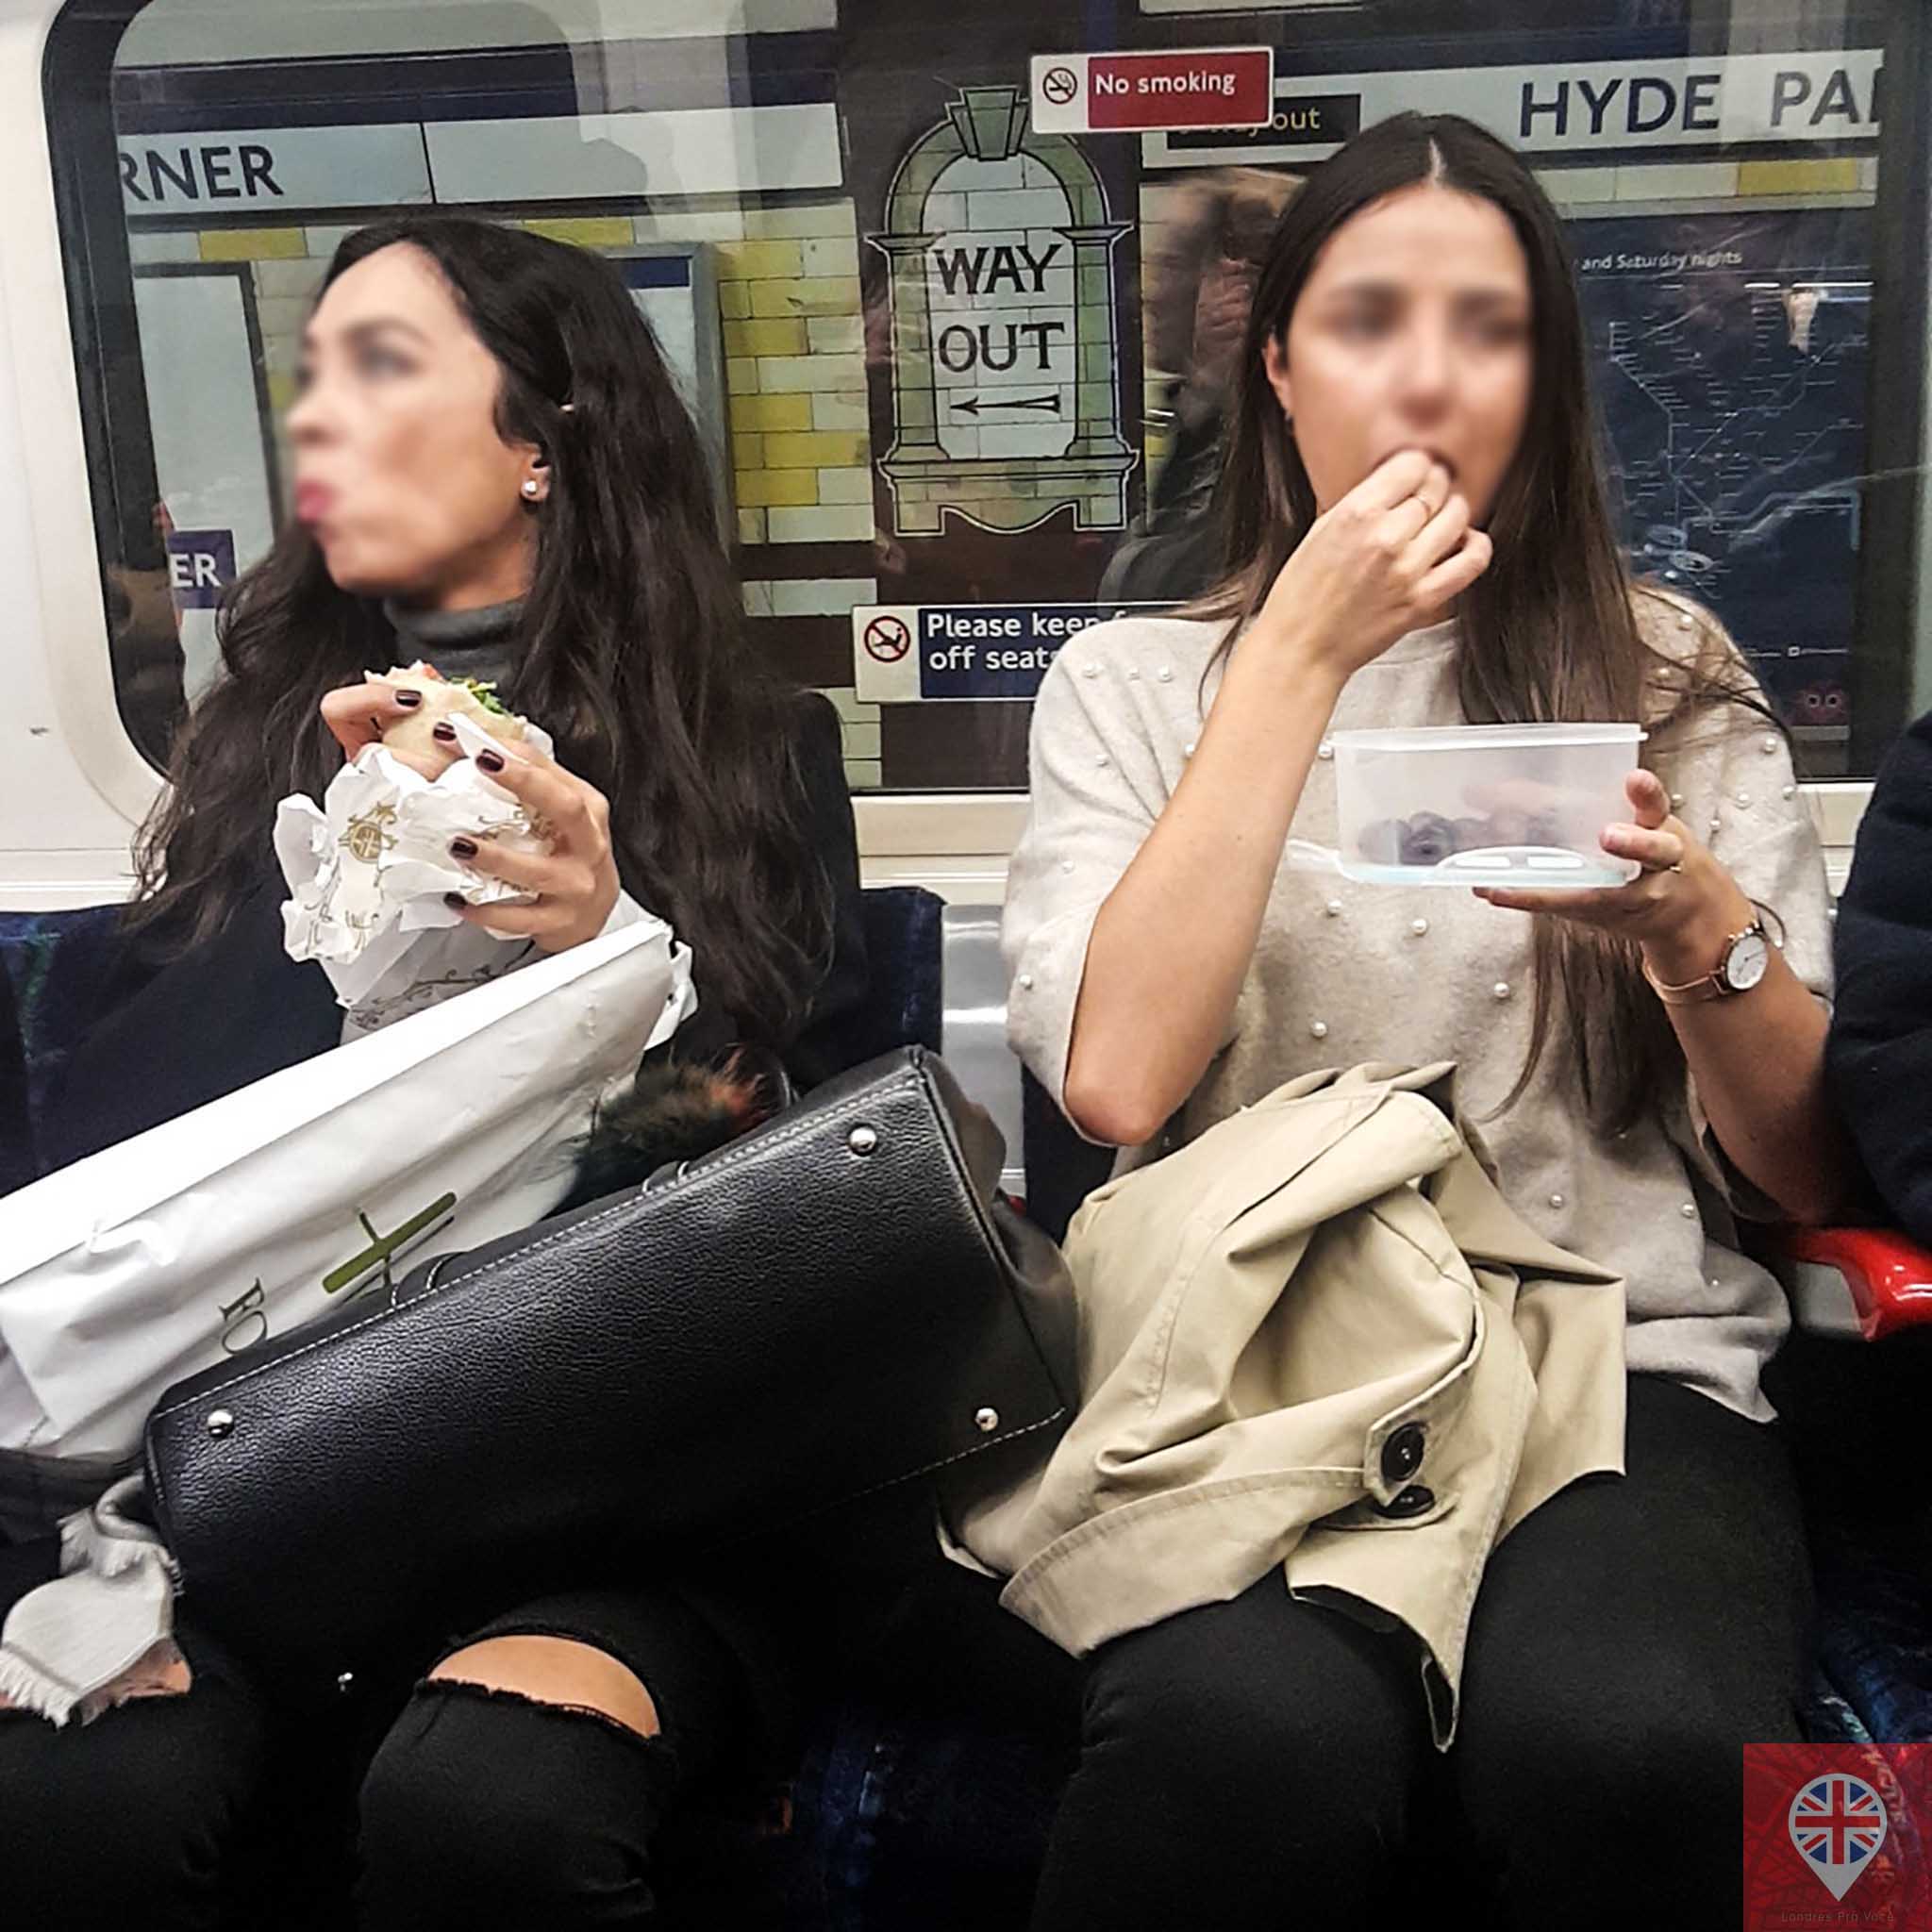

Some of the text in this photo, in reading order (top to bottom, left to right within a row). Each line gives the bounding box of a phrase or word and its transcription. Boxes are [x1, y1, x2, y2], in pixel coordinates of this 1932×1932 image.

[1095, 70, 1237, 95] No smoking
[1273, 107, 1321, 130] out
[1519, 74, 1722, 138] HYDE
[931, 242, 1064, 295] WAY
[1581, 254, 1612, 271] and
[1617, 251, 1688, 271] Saturday
[939, 322, 1065, 373] OUT
[170, 552, 223, 588] ER
[927, 613, 1022, 639] Please
[929, 645, 976, 671] off
